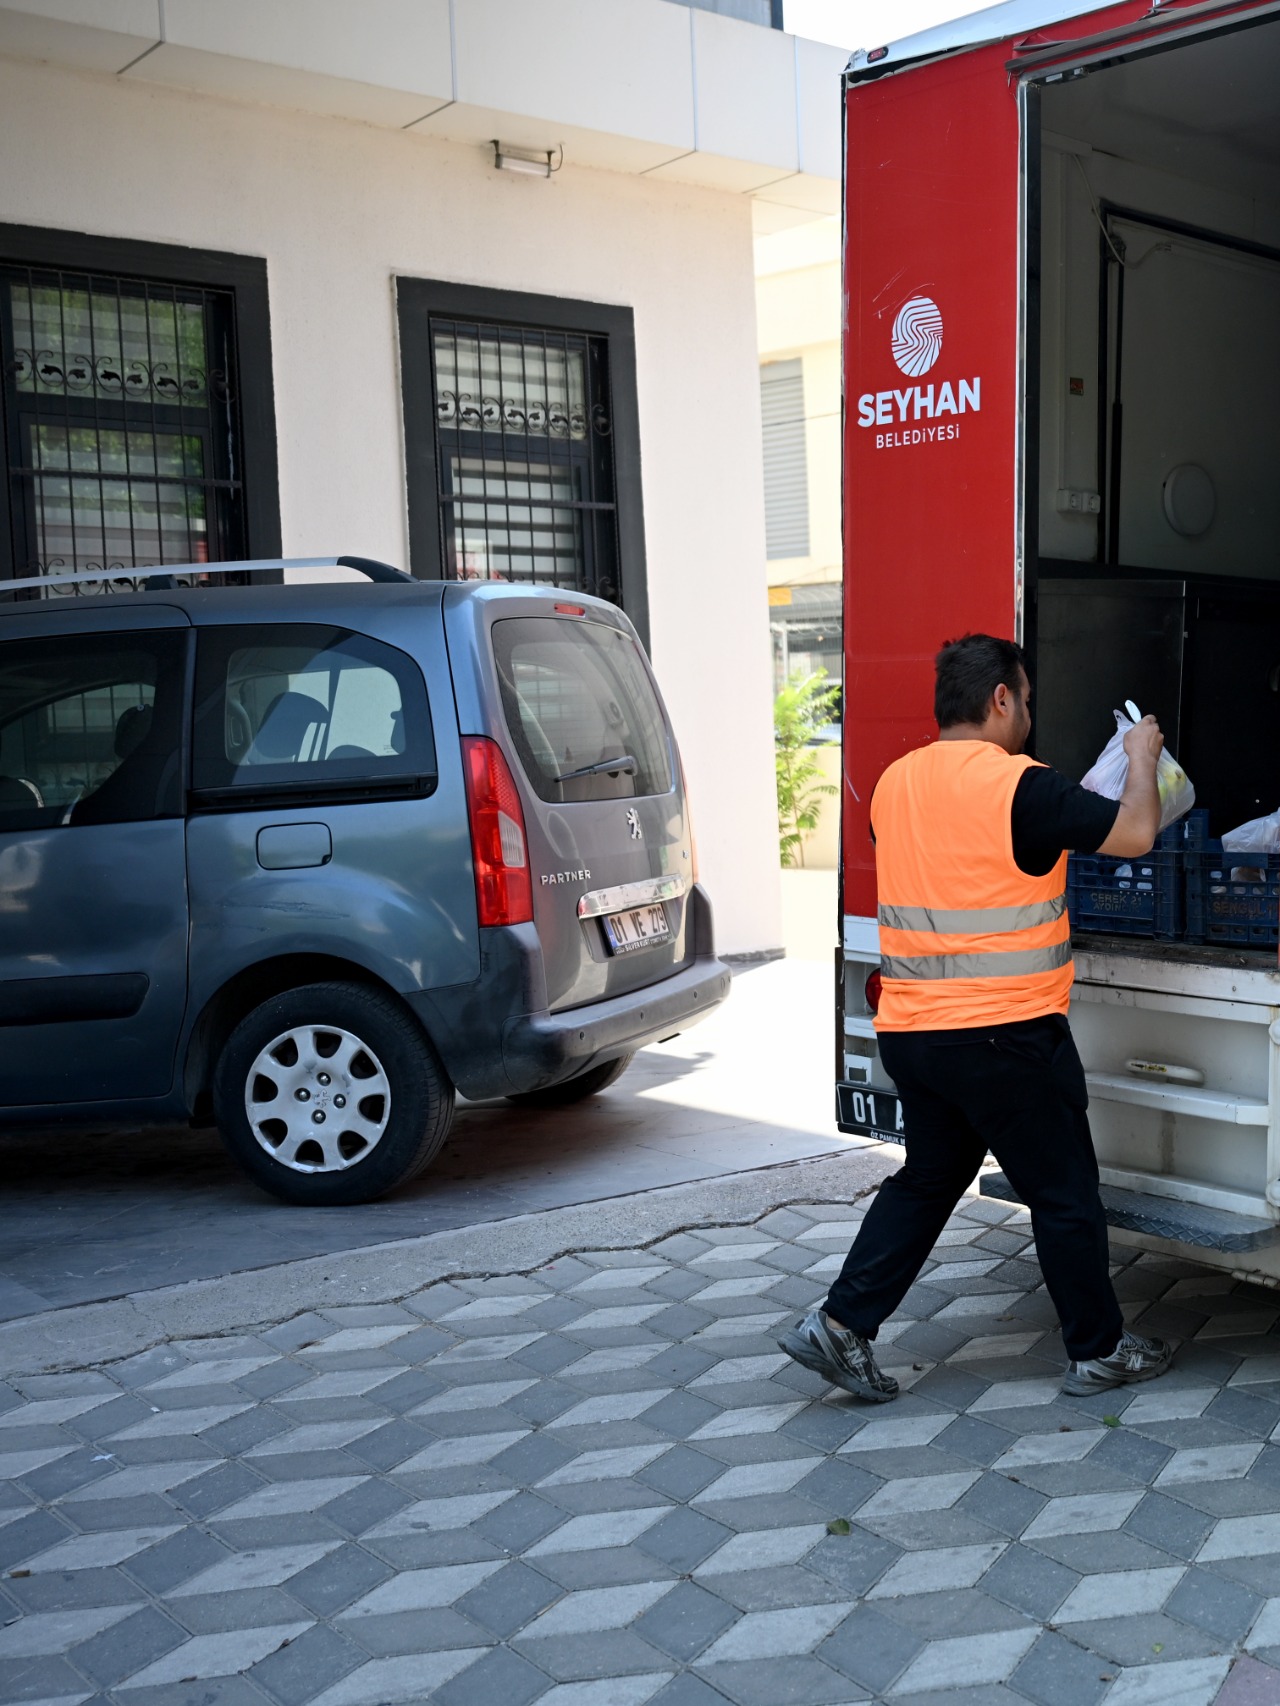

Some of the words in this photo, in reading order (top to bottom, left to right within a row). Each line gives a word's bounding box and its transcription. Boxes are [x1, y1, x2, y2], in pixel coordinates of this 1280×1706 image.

[857, 376, 981, 428] SEYHAN
[541, 869, 591, 886] PARTNER
[610, 916, 628, 943] 01
[629, 911, 647, 937] VE
[648, 906, 667, 933] 279
[852, 1091, 877, 1126] 01
